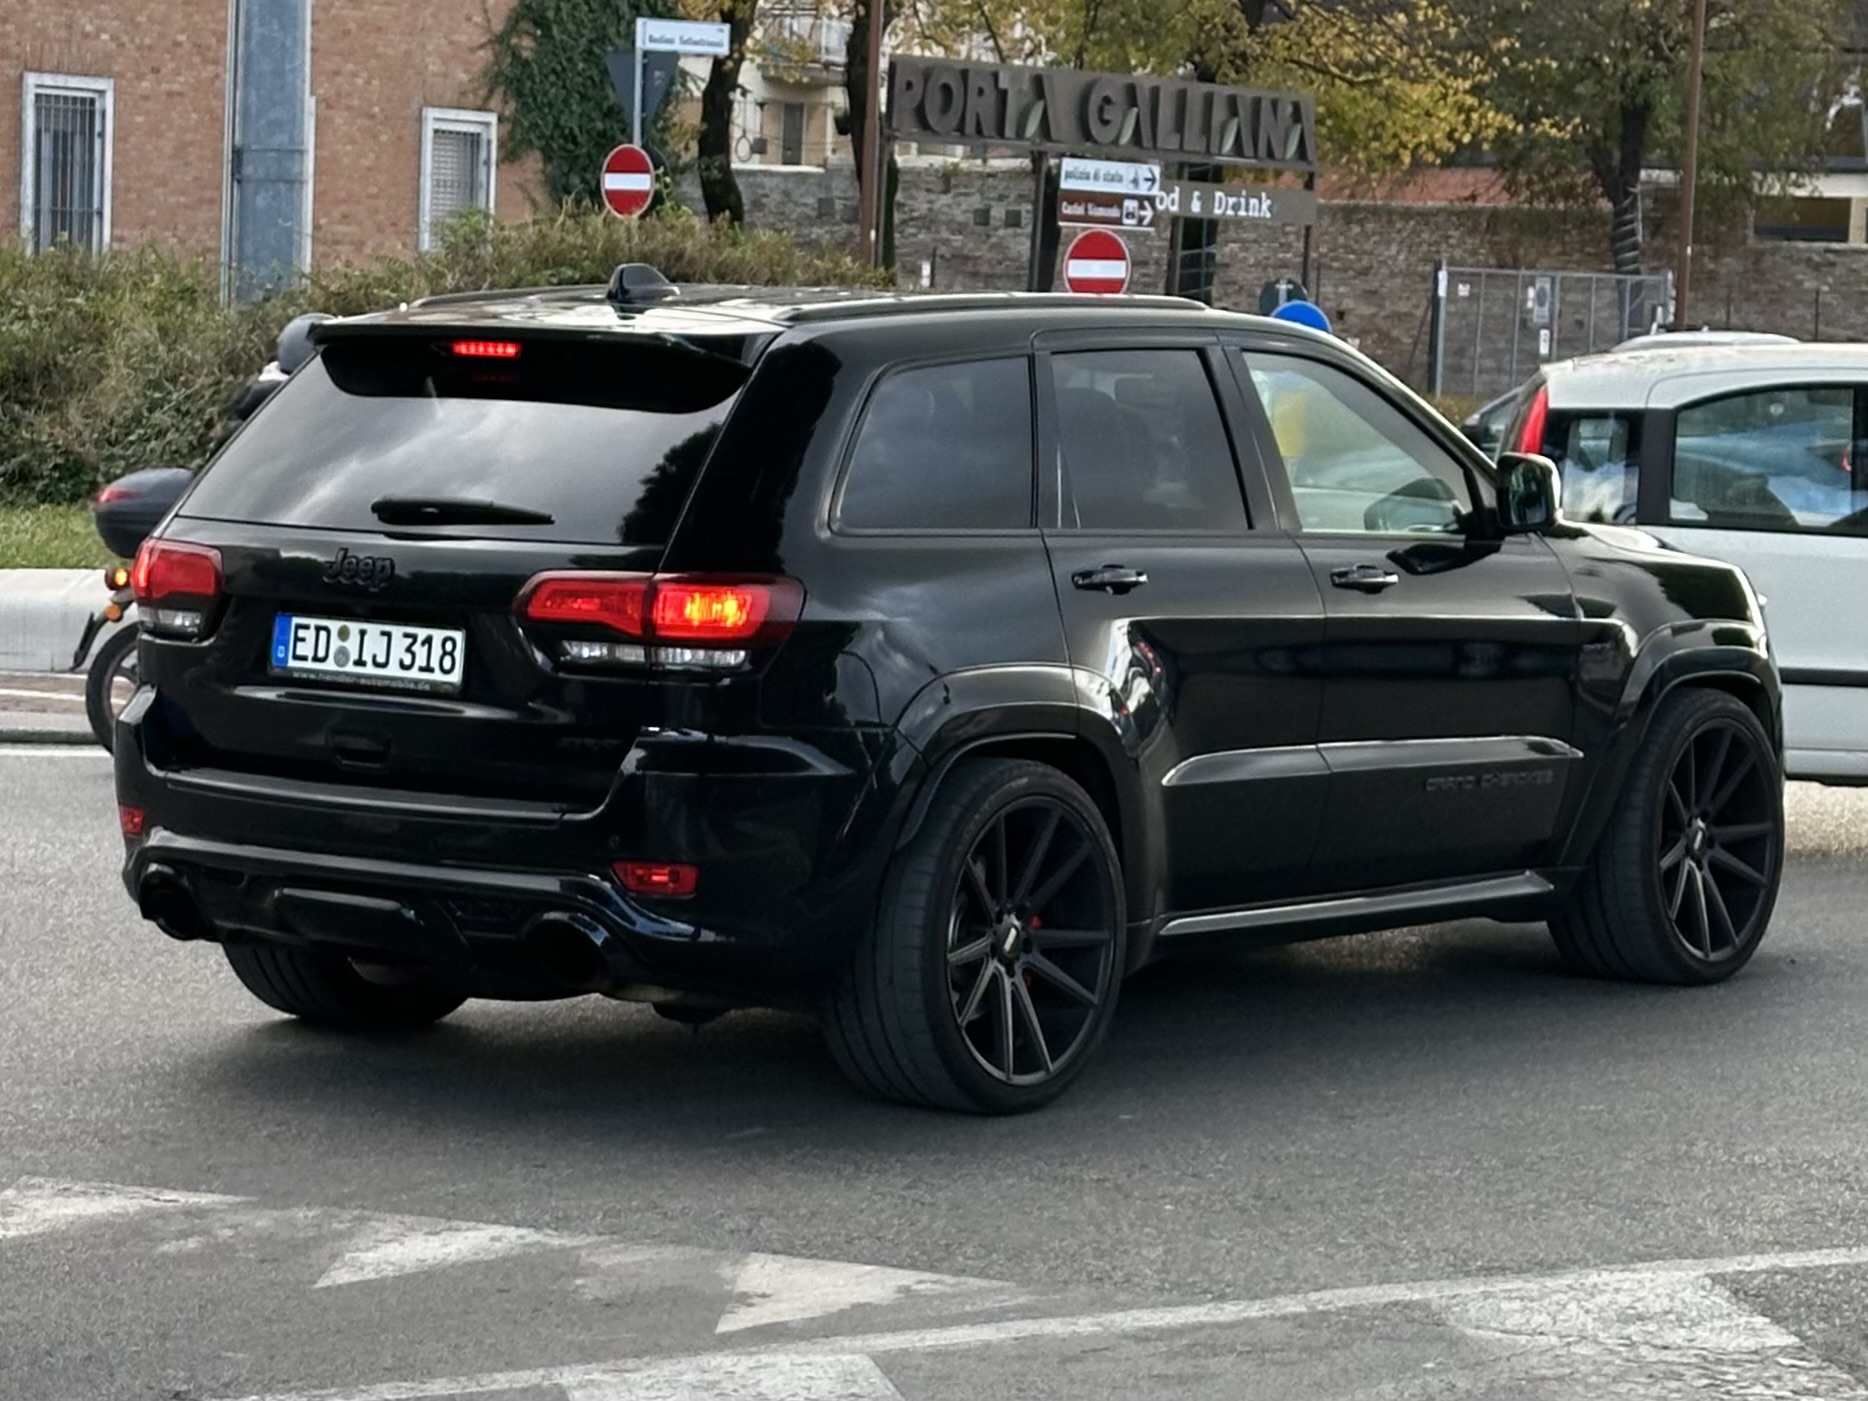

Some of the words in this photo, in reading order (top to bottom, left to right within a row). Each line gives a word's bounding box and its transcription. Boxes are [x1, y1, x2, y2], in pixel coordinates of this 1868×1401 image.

[889, 60, 1058, 141] PORTA
[1086, 78, 1316, 162] GALLIANA
[1191, 190, 1202, 214] &
[1213, 189, 1272, 219] Drink
[322, 546, 396, 593] Jeep
[291, 623, 331, 664] ED
